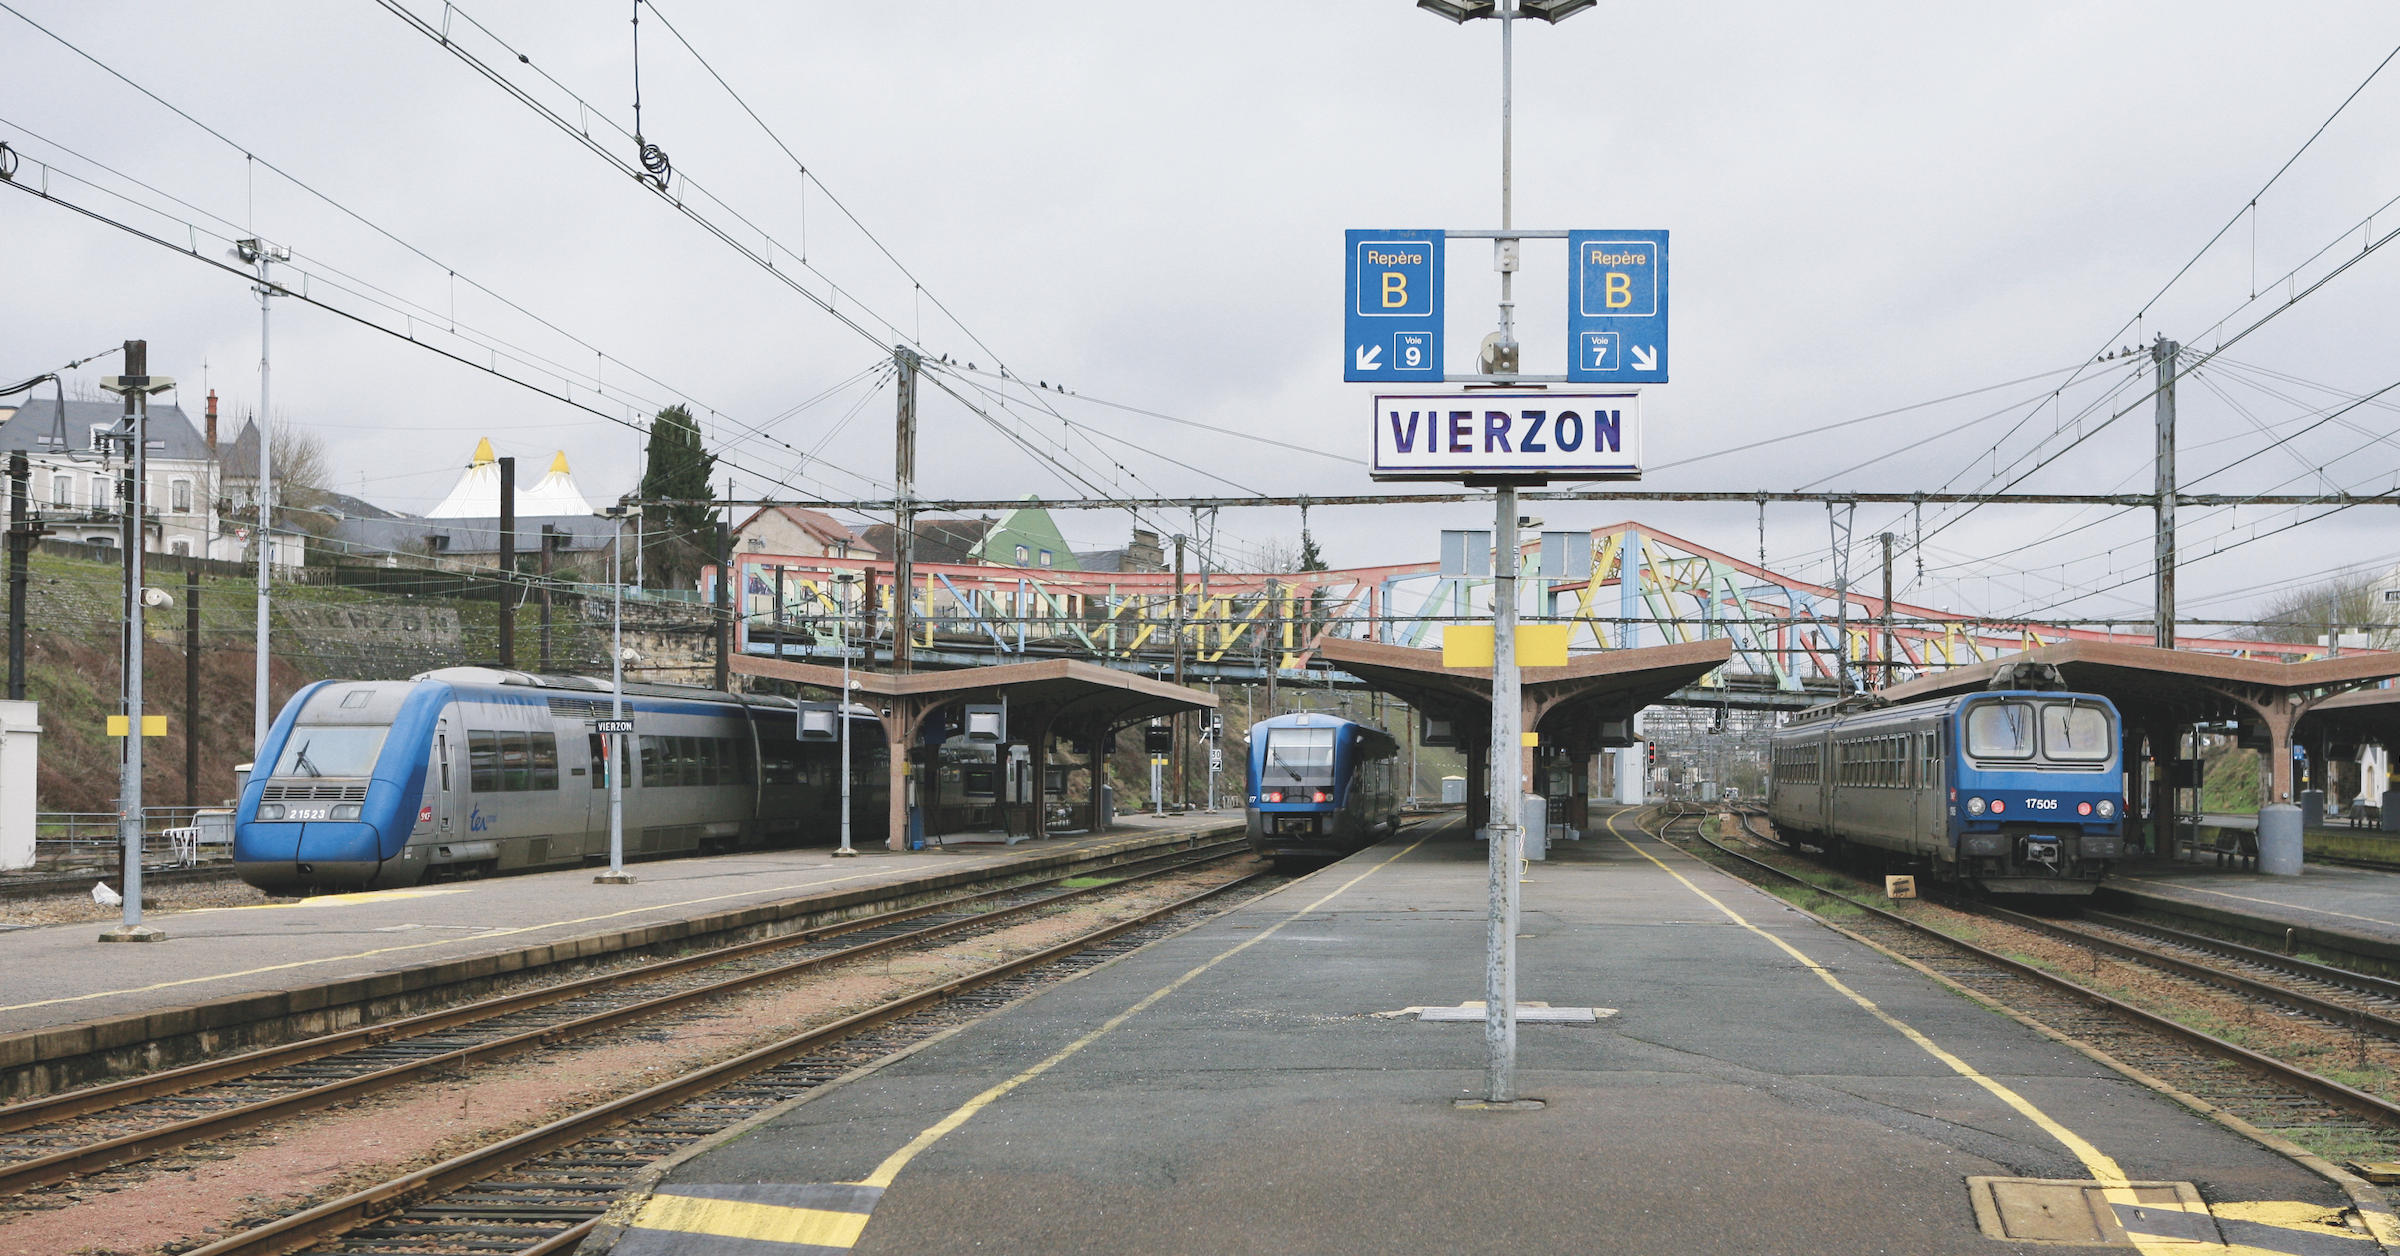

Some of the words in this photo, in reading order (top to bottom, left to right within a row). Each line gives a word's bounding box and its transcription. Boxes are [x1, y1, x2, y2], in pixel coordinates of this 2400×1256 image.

[1368, 250, 1422, 267] Repère
[1591, 250, 1646, 268] Repère
[1382, 272, 1408, 308] B
[1605, 272, 1633, 308] B
[1405, 336, 1422, 345] Voie
[1591, 336, 1609, 345] Voie
[1405, 347, 1421, 367] 9
[1592, 347, 1607, 367] 7
[1390, 410, 1621, 452] VIERZON
[598, 721, 632, 731] VIERZON
[1212, 750, 1221, 759] 30
[2025, 798, 2058, 810] 17505
[289, 809, 326, 819] 21523
[420, 811, 432, 821] SNCF
